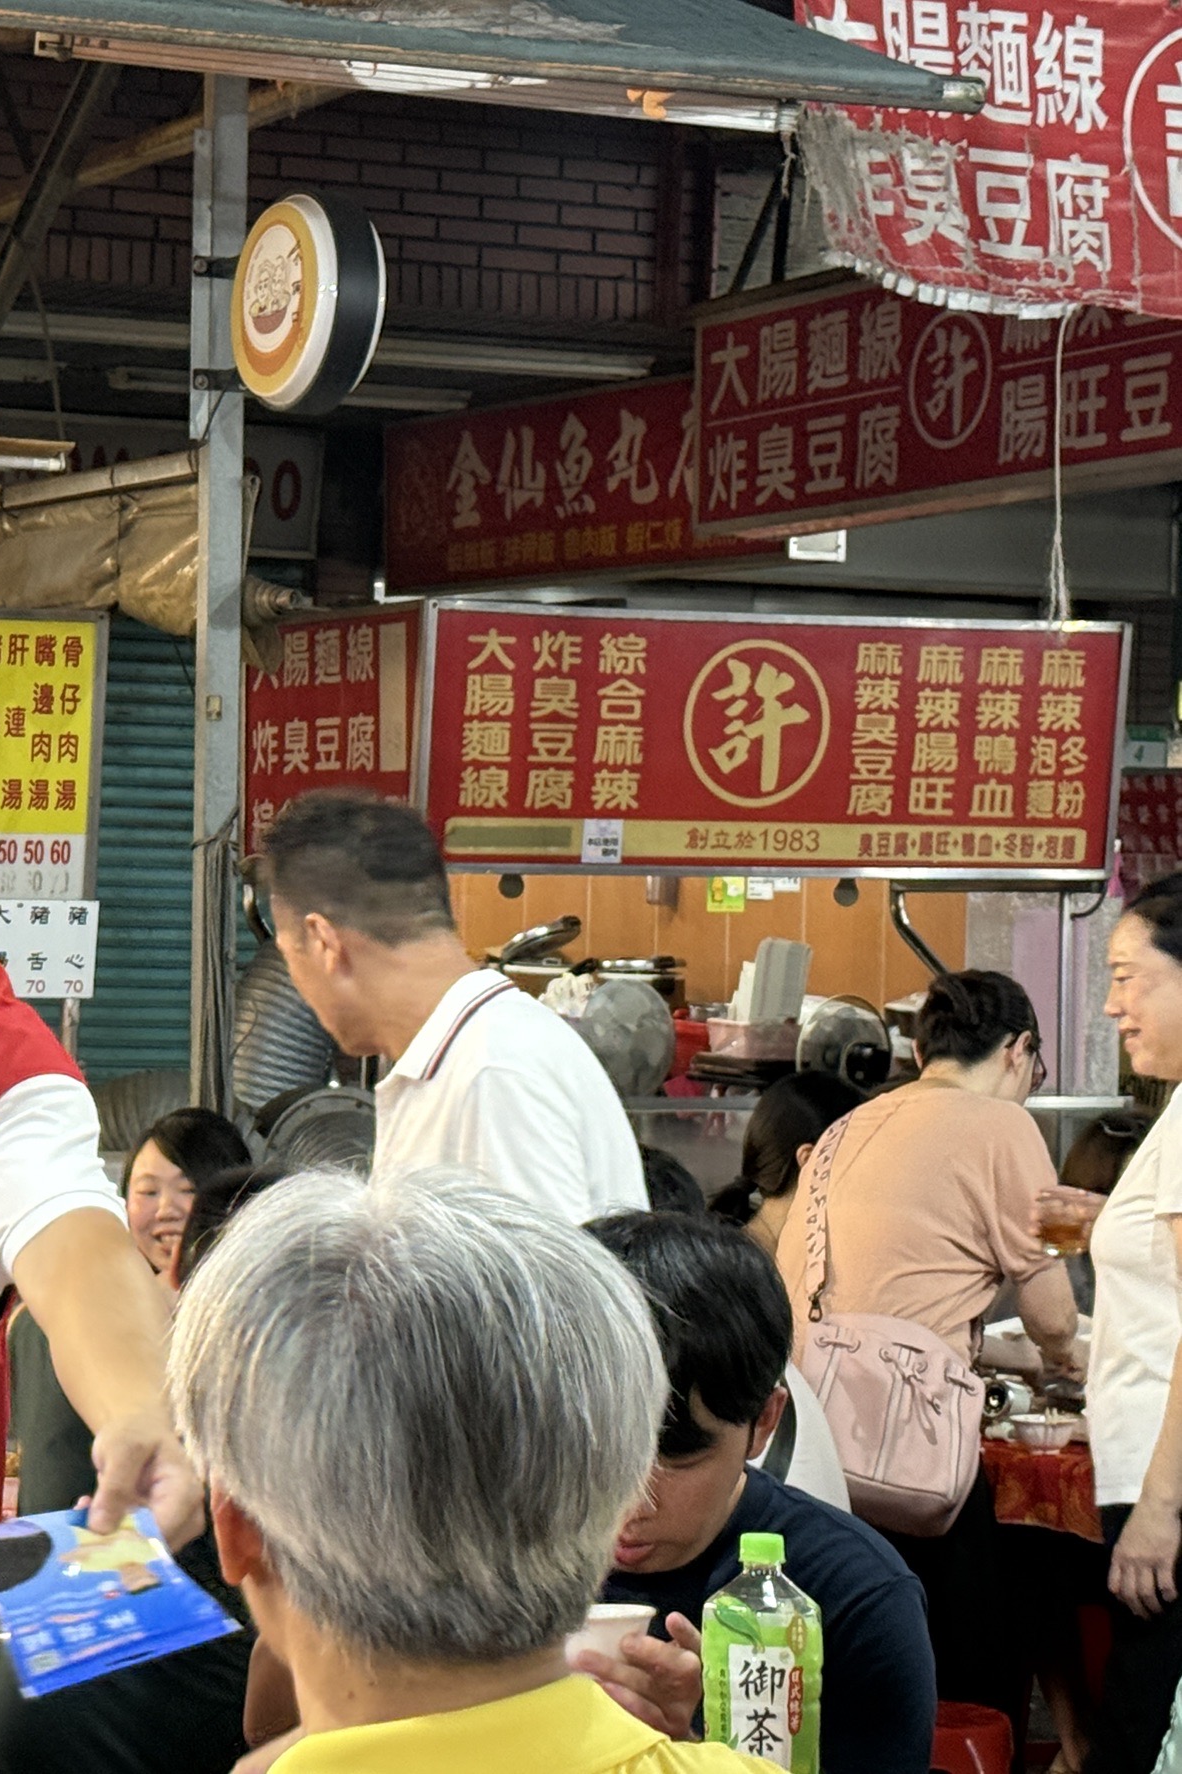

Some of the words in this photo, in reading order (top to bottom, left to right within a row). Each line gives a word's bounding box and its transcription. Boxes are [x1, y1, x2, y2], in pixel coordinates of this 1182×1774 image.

[709, 300, 902, 414] 大腸麵線
[923, 325, 979, 436] 許
[706, 403, 901, 512] 炸臭豆腐
[0, 633, 30, 810] 肝連湯
[27, 634, 57, 811] 嘴邊肉湯
[54, 636, 84, 811] 骨仔肉湯
[252, 712, 375, 775] 炸臭豆腐
[459, 628, 517, 809] 大腸麵線
[524, 629, 583, 810] 炸臭豆腐
[590, 632, 647, 811] 綜合麻辣
[708, 658, 811, 792] 許
[846, 641, 903, 817] 麻辣臭豆腐
[908, 643, 965, 817] 麻辣腸旺
[969, 645, 1024, 819] 麻辣鴨血
[24, 840, 44, 865] 50
[50, 840, 71, 865] 60
[685, 827, 821, 854] 創立於1983
[26, 979, 46, 994] 70
[64, 979, 84, 994] 70
